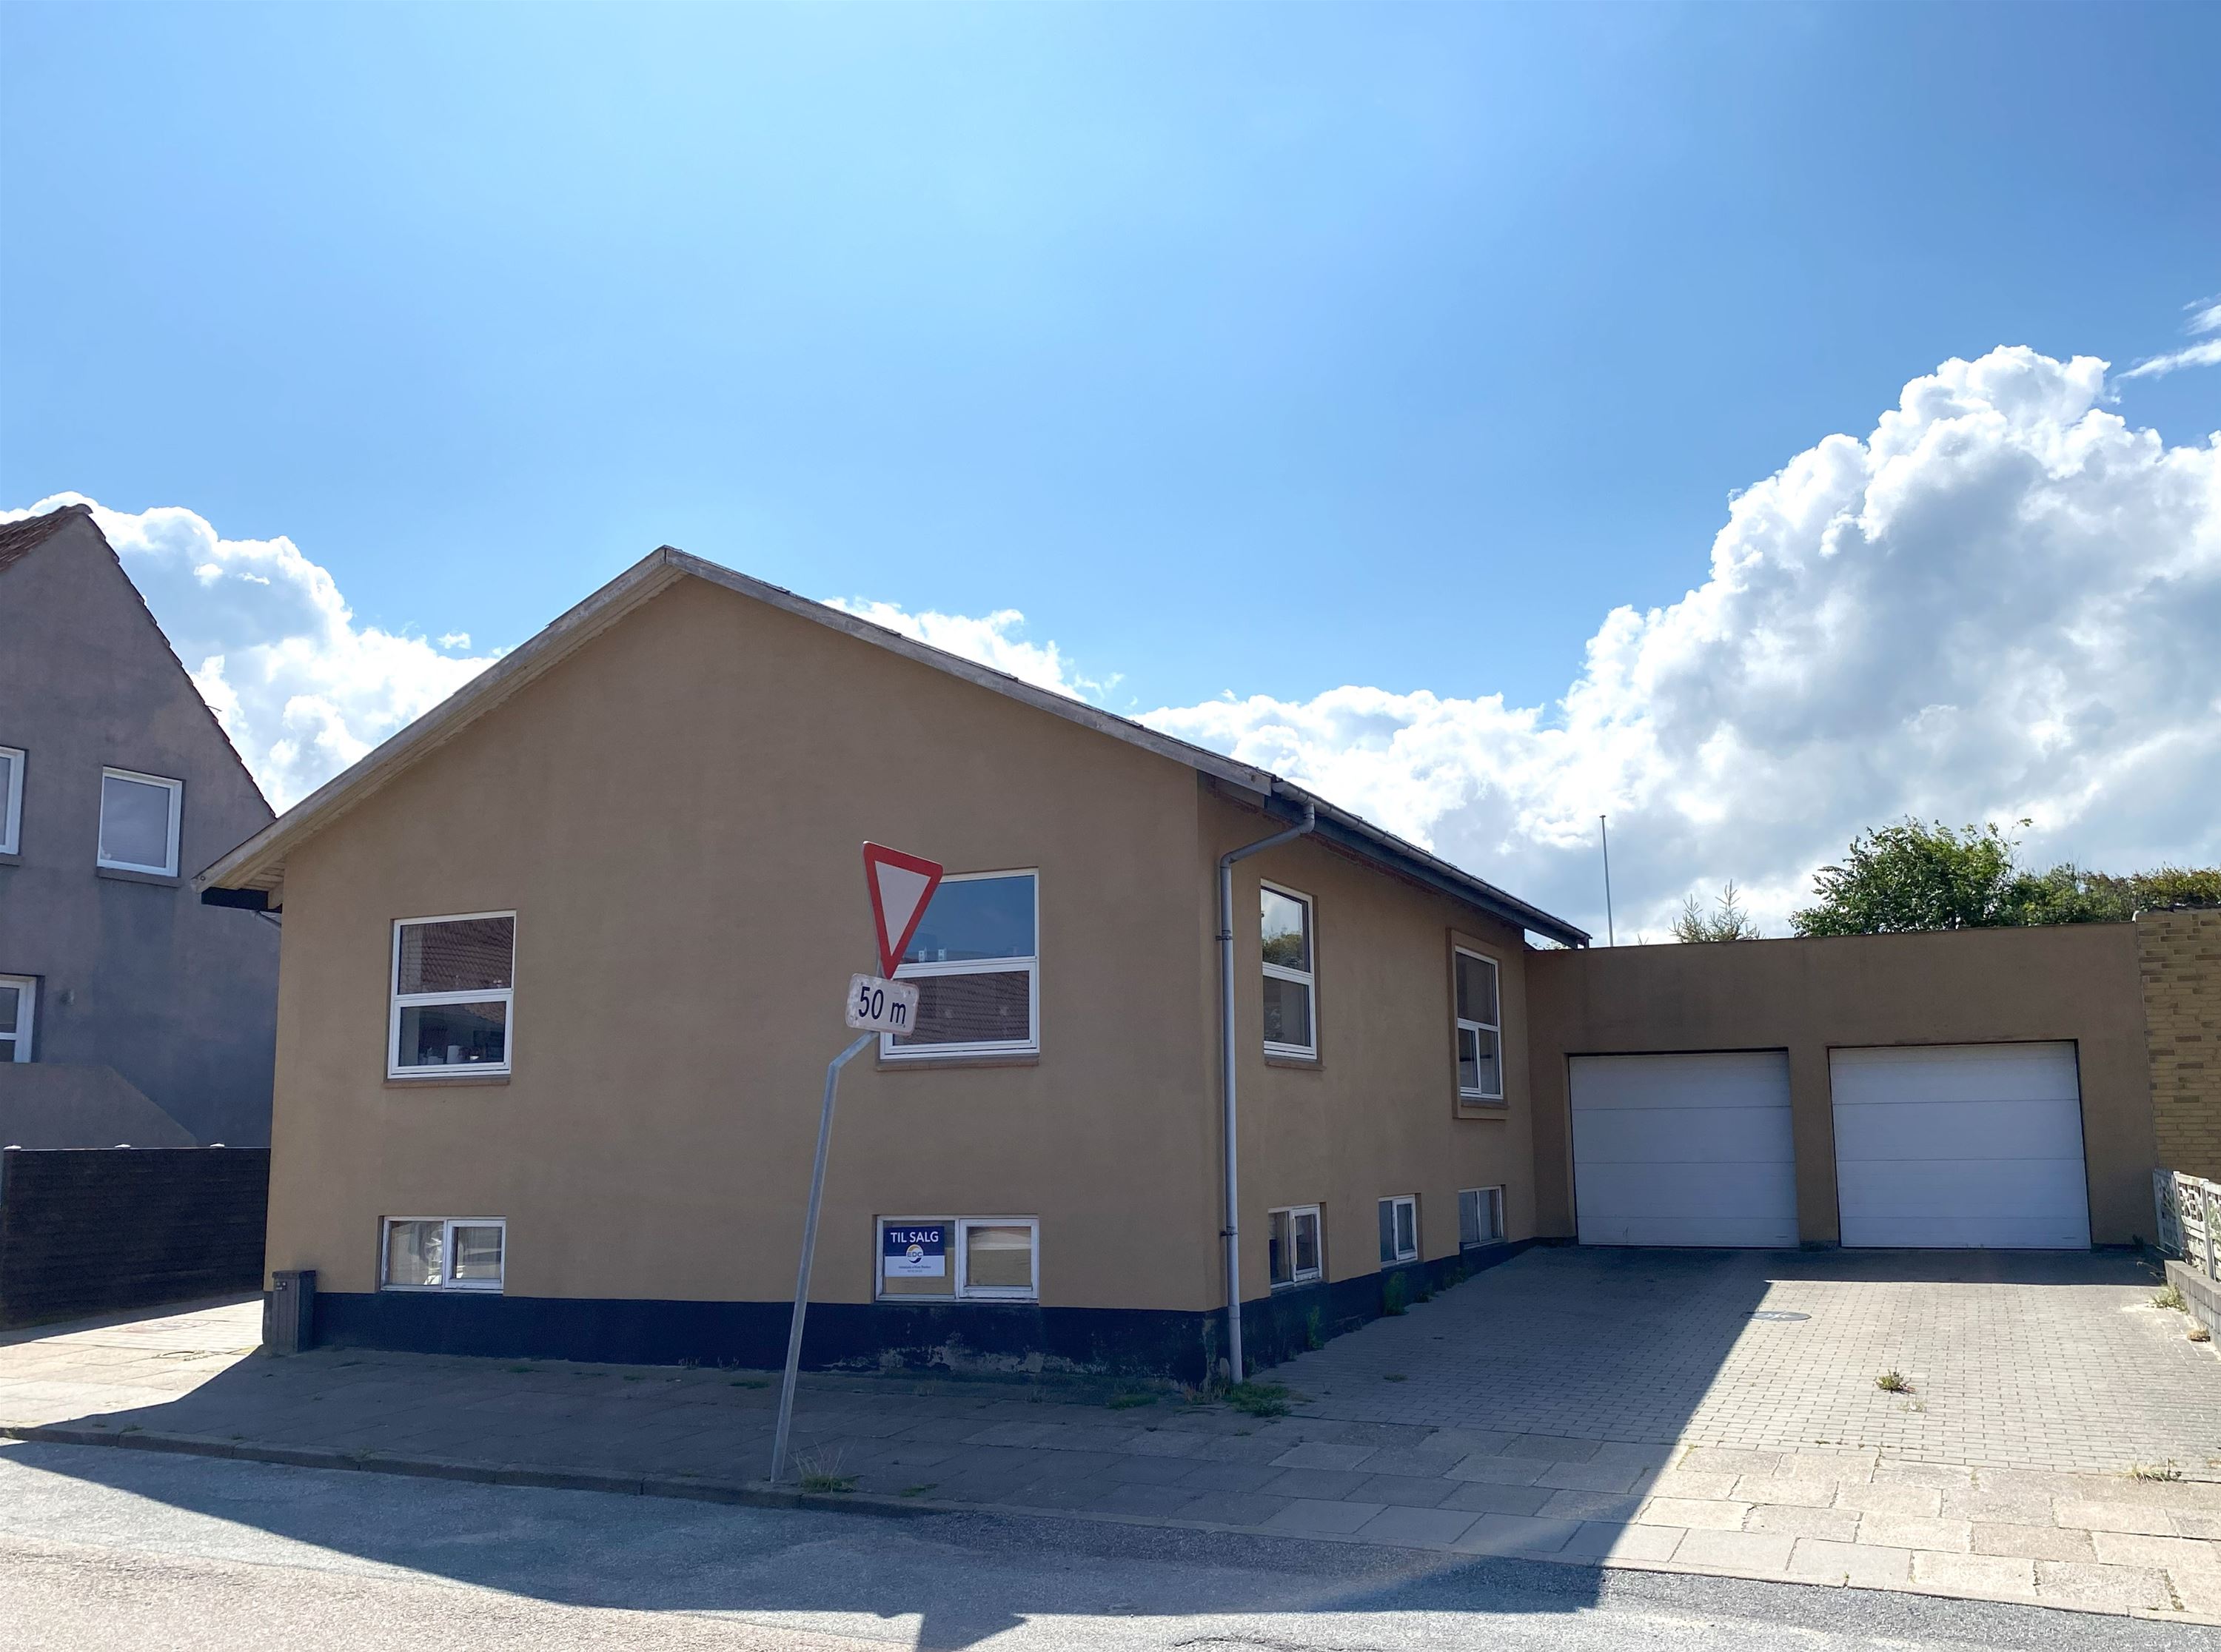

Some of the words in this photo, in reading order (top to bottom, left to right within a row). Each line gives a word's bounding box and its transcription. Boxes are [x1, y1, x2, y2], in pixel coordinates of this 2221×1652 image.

[859, 986, 884, 1020] 50
[889, 1002, 906, 1024] m
[891, 1232, 907, 1243] TIL
[909, 1232, 939, 1243] SALG
